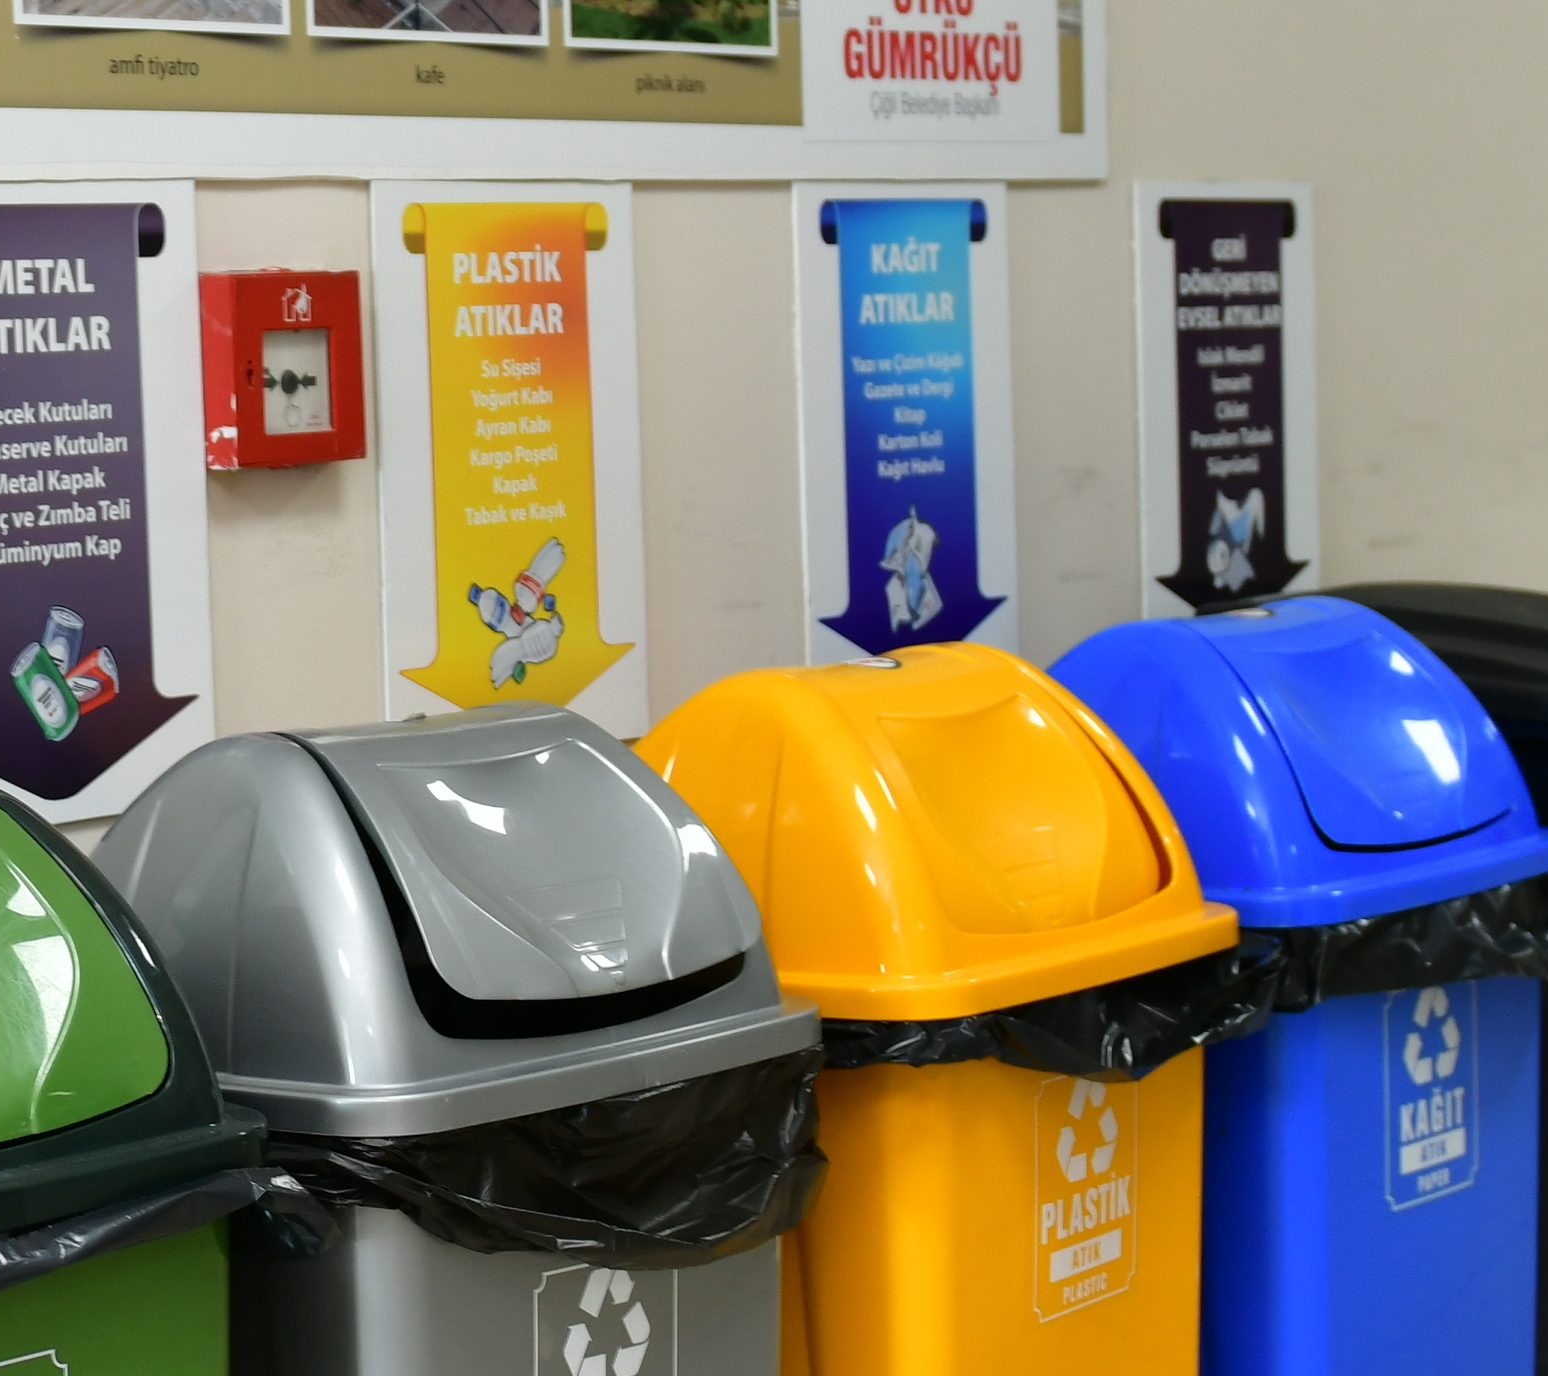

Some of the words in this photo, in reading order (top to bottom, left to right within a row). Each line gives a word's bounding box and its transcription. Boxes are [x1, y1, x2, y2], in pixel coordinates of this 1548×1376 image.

[109, 55, 144, 76] amfi
[148, 56, 200, 80] tiyatro
[843, 16, 1022, 97] GÜMRÜKÇÜ
[415, 64, 445, 86] kafe
[452, 243, 562, 284] PLASTİK
[871, 236, 941, 274] KAĞIT
[454, 303, 564, 337] ATIKLAR
[860, 291, 954, 325] ATIKLAR
[481, 359, 500, 378] Su
[38, 399, 112, 423] Kutuları
[471, 389, 519, 411] Yoğurt
[521, 386, 553, 405] Kabı
[476, 419, 517, 440] Ayran
[519, 415, 551, 433] Kabı
[54, 432, 128, 457] Kutuları
[470, 449, 512, 470] Kargo
[515, 444, 558, 466] Poşeti
[47, 466, 106, 493] Kapak
[493, 473, 538, 497] Kapak
[13, 510, 34, 527] ve
[38, 502, 97, 527] Zımba
[98, 498, 131, 521] Teli
[464, 505, 508, 525] Tabak
[510, 509, 527, 521] ve
[85, 535, 122, 560] Kap
[1399, 1086, 1465, 1142] KAĞIT
[1041, 1171, 1130, 1245] PLASTİK
[1072, 1242, 1101, 1269] ATIK
[1063, 1272, 1108, 1305] PLASTIC
